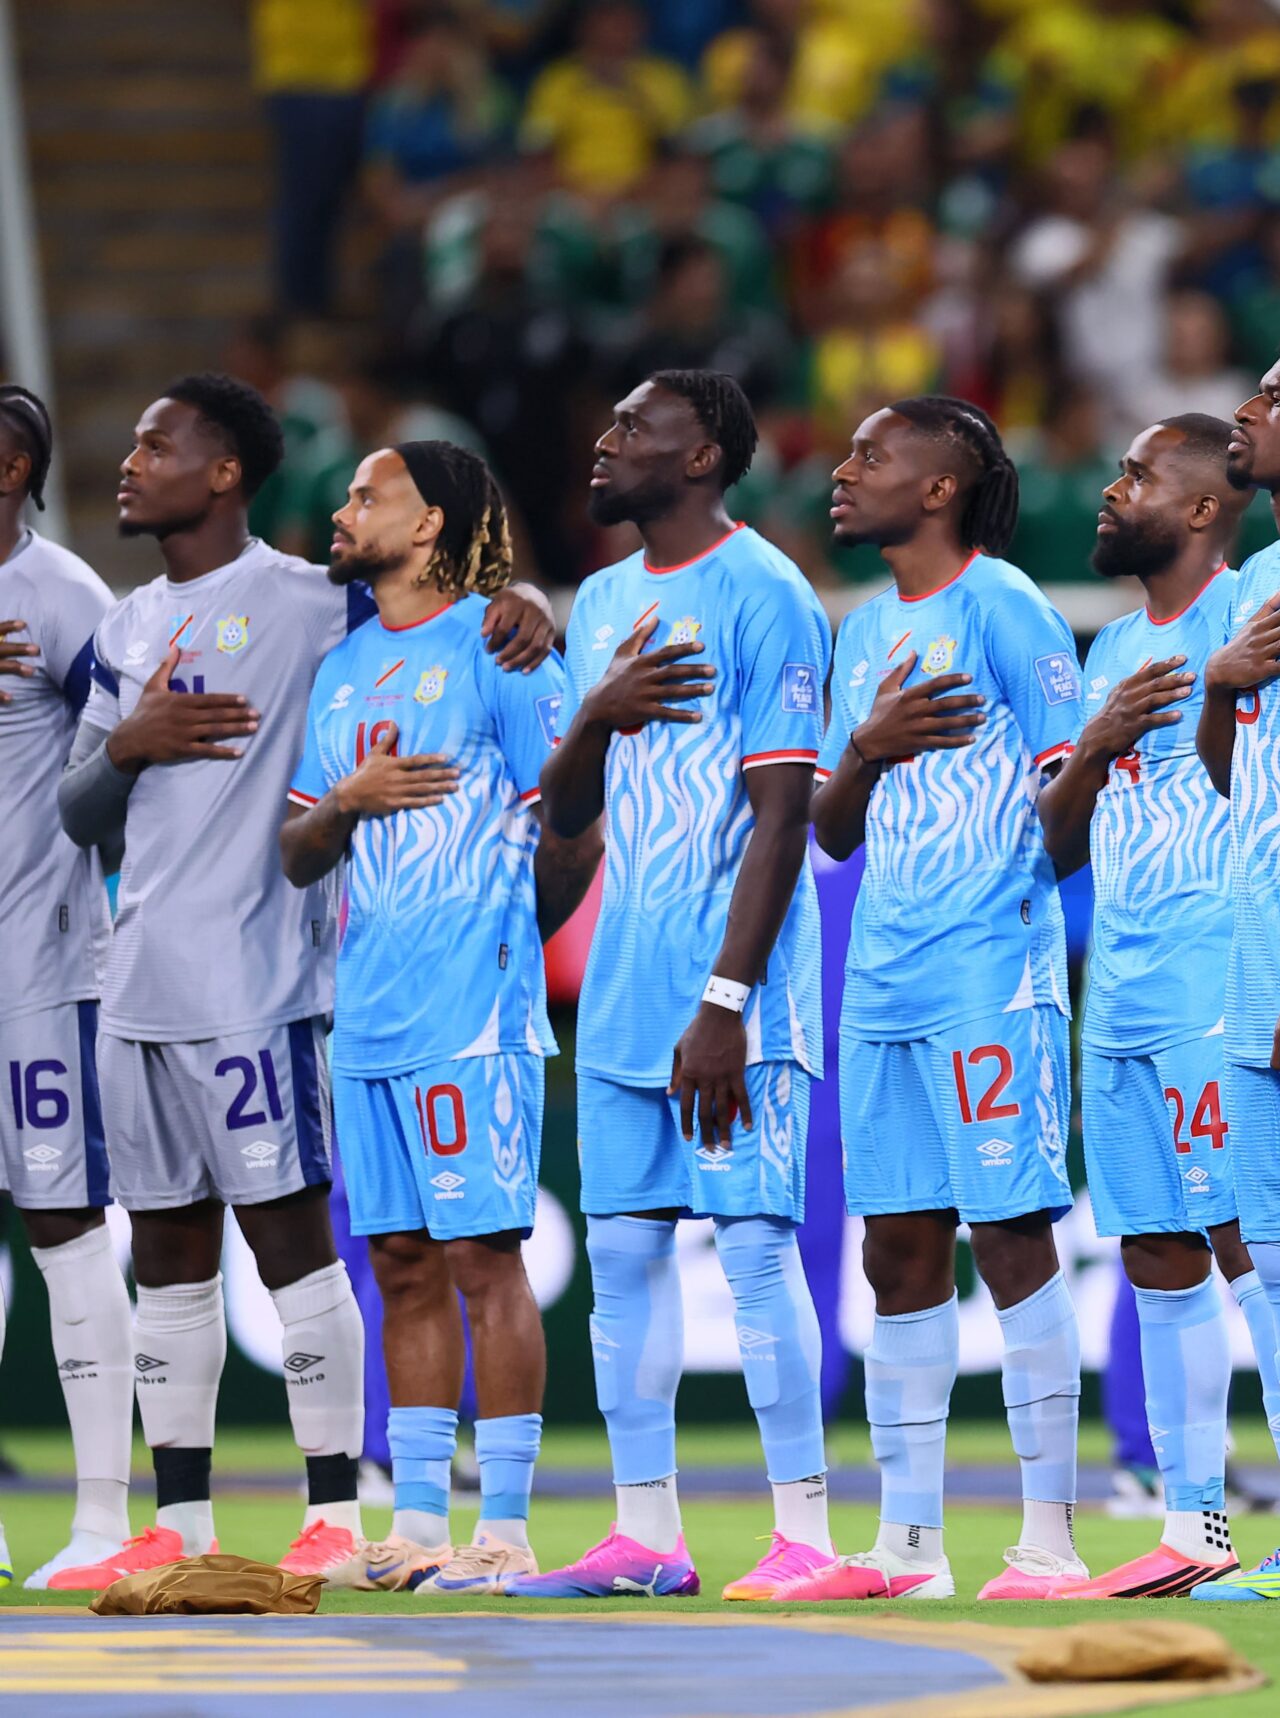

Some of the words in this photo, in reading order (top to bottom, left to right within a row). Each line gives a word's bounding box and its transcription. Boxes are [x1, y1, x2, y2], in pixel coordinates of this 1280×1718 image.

[9, 1059, 69, 1130] 16
[215, 1049, 284, 1131] 21
[952, 1043, 1021, 1125] 12
[1164, 1081, 1229, 1154] 24
[415, 1083, 468, 1158] 10
[434, 1190, 465, 1201] umbro
[981, 1157, 1012, 1167] umbro
[287, 1373, 325, 1386] mbro
